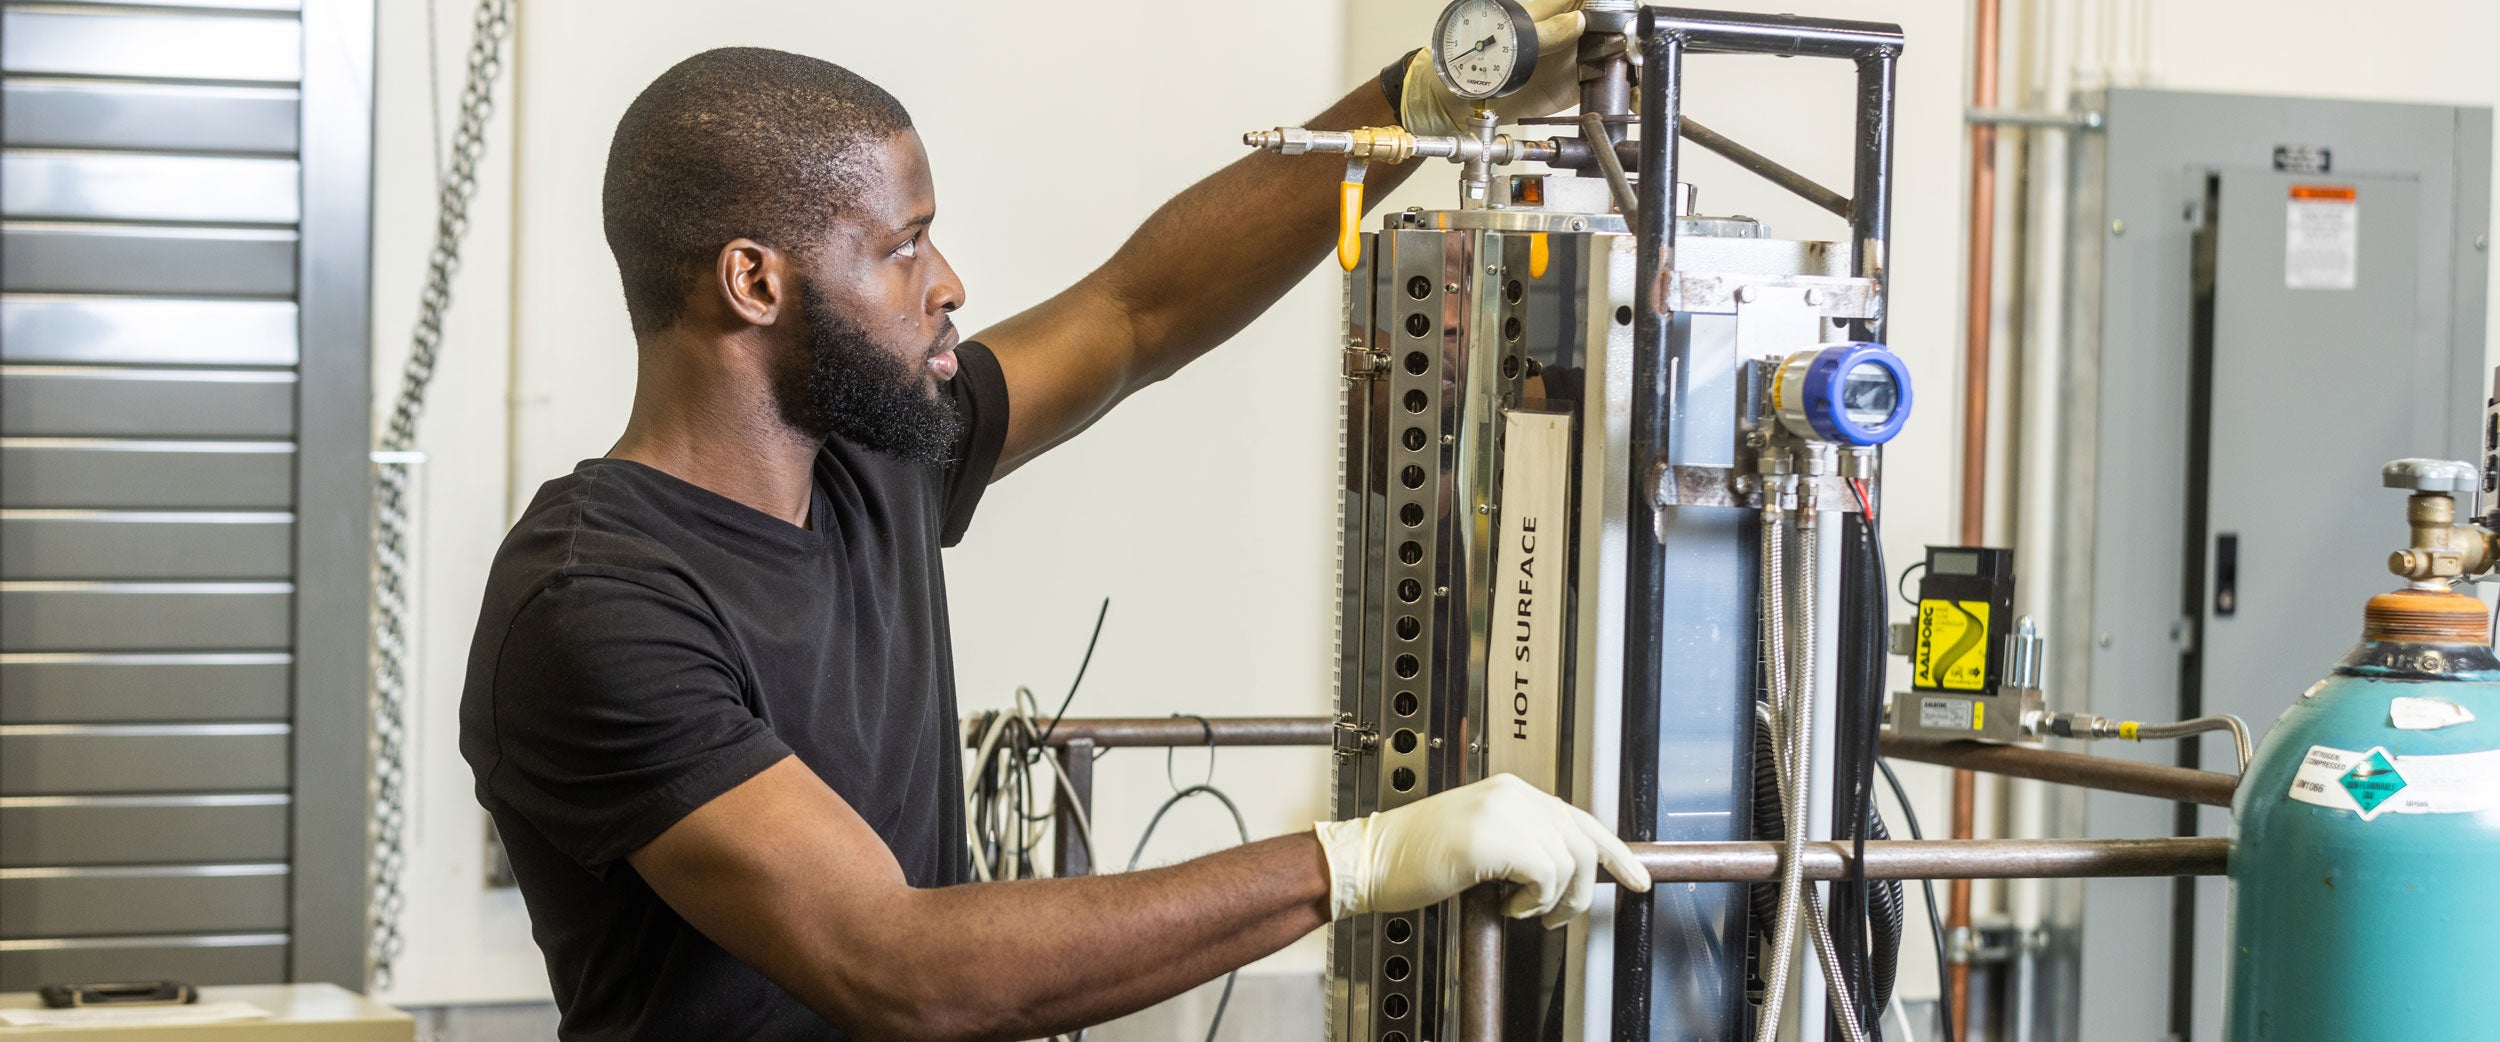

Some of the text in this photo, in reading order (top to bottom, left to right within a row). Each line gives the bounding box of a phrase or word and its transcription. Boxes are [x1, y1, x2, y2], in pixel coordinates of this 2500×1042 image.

[1513, 516, 1537, 740] HOT SURFACE
[1919, 606, 1933, 681] AALBORG
[2296, 778, 2325, 793] UN1066
[2305, 757, 2346, 771] COMPRESSED
